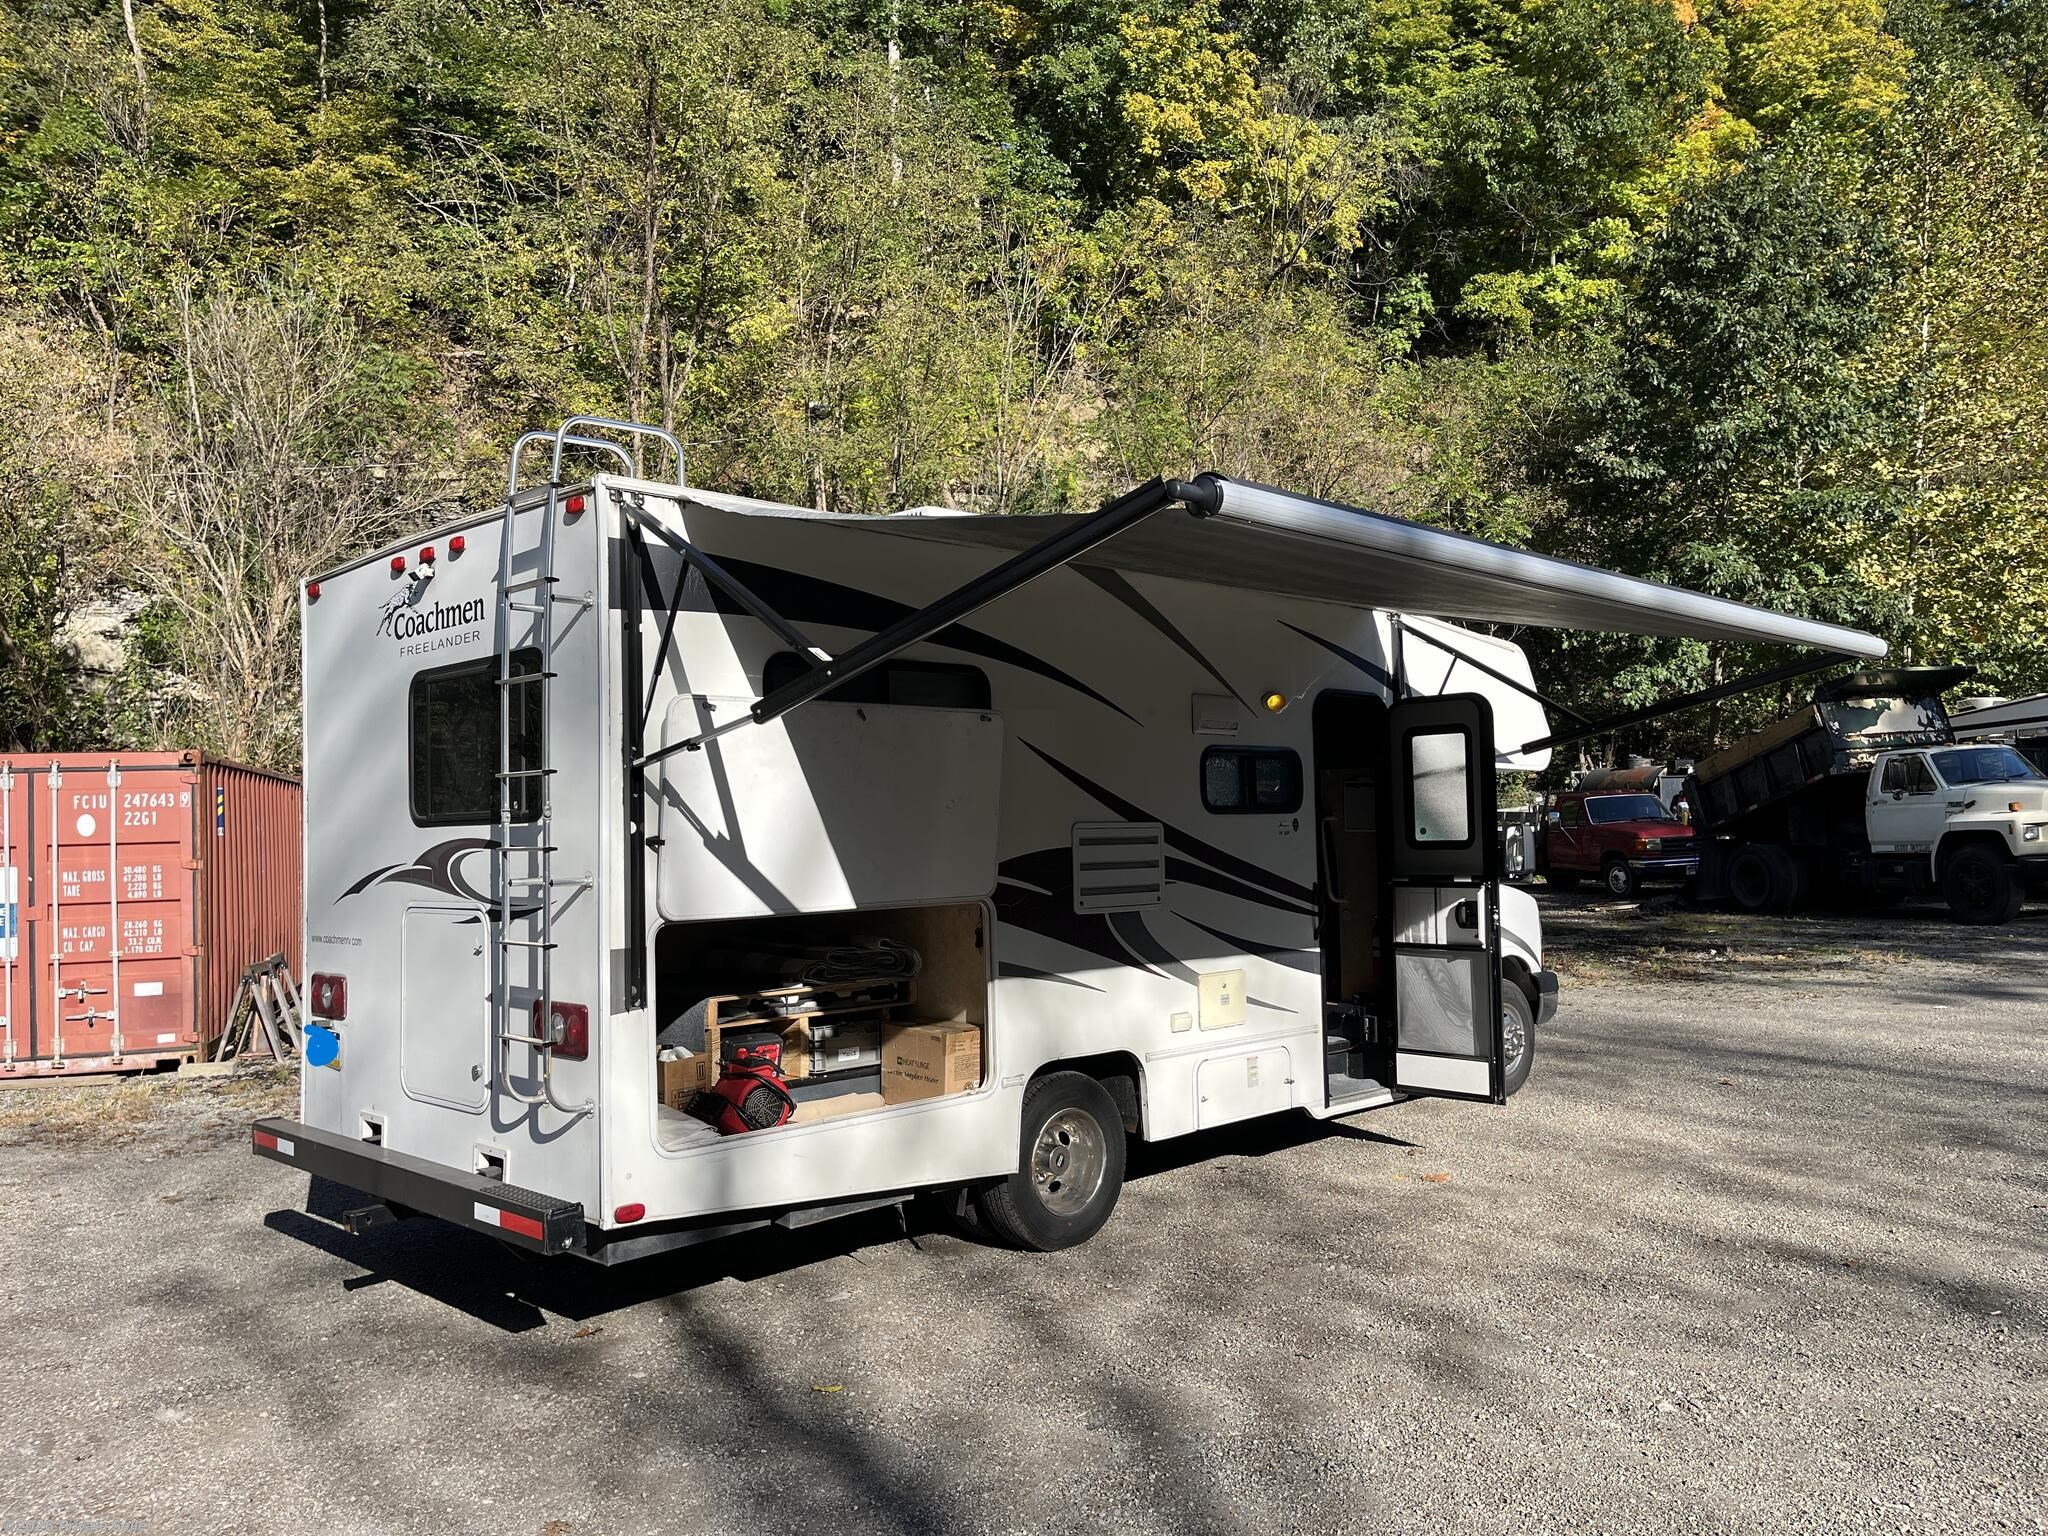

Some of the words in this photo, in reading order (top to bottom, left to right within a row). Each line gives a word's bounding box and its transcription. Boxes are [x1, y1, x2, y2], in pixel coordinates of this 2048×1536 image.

[394, 598, 485, 640] Coachmen
[400, 630, 481, 657] FREELANDER
[73, 794, 107, 809] FCIU
[123, 793, 175, 808] 247643
[124, 811, 157, 825] 22G1
[152, 865, 162, 873] KG
[63, 871, 80, 883] MAX.
[82, 870, 106, 882] GROSS
[153, 873, 162, 881] LB
[63, 885, 81, 897] TARE
[153, 882, 162, 890] KG
[153, 890, 162, 898] LB
[153, 919, 162, 928] KG
[63, 927, 81, 939] MAX.
[82, 926, 106, 938] CARGO
[153, 928, 162, 936] LB
[63, 941, 75, 953] CU.
[79, 941, 96, 952] CAP.
